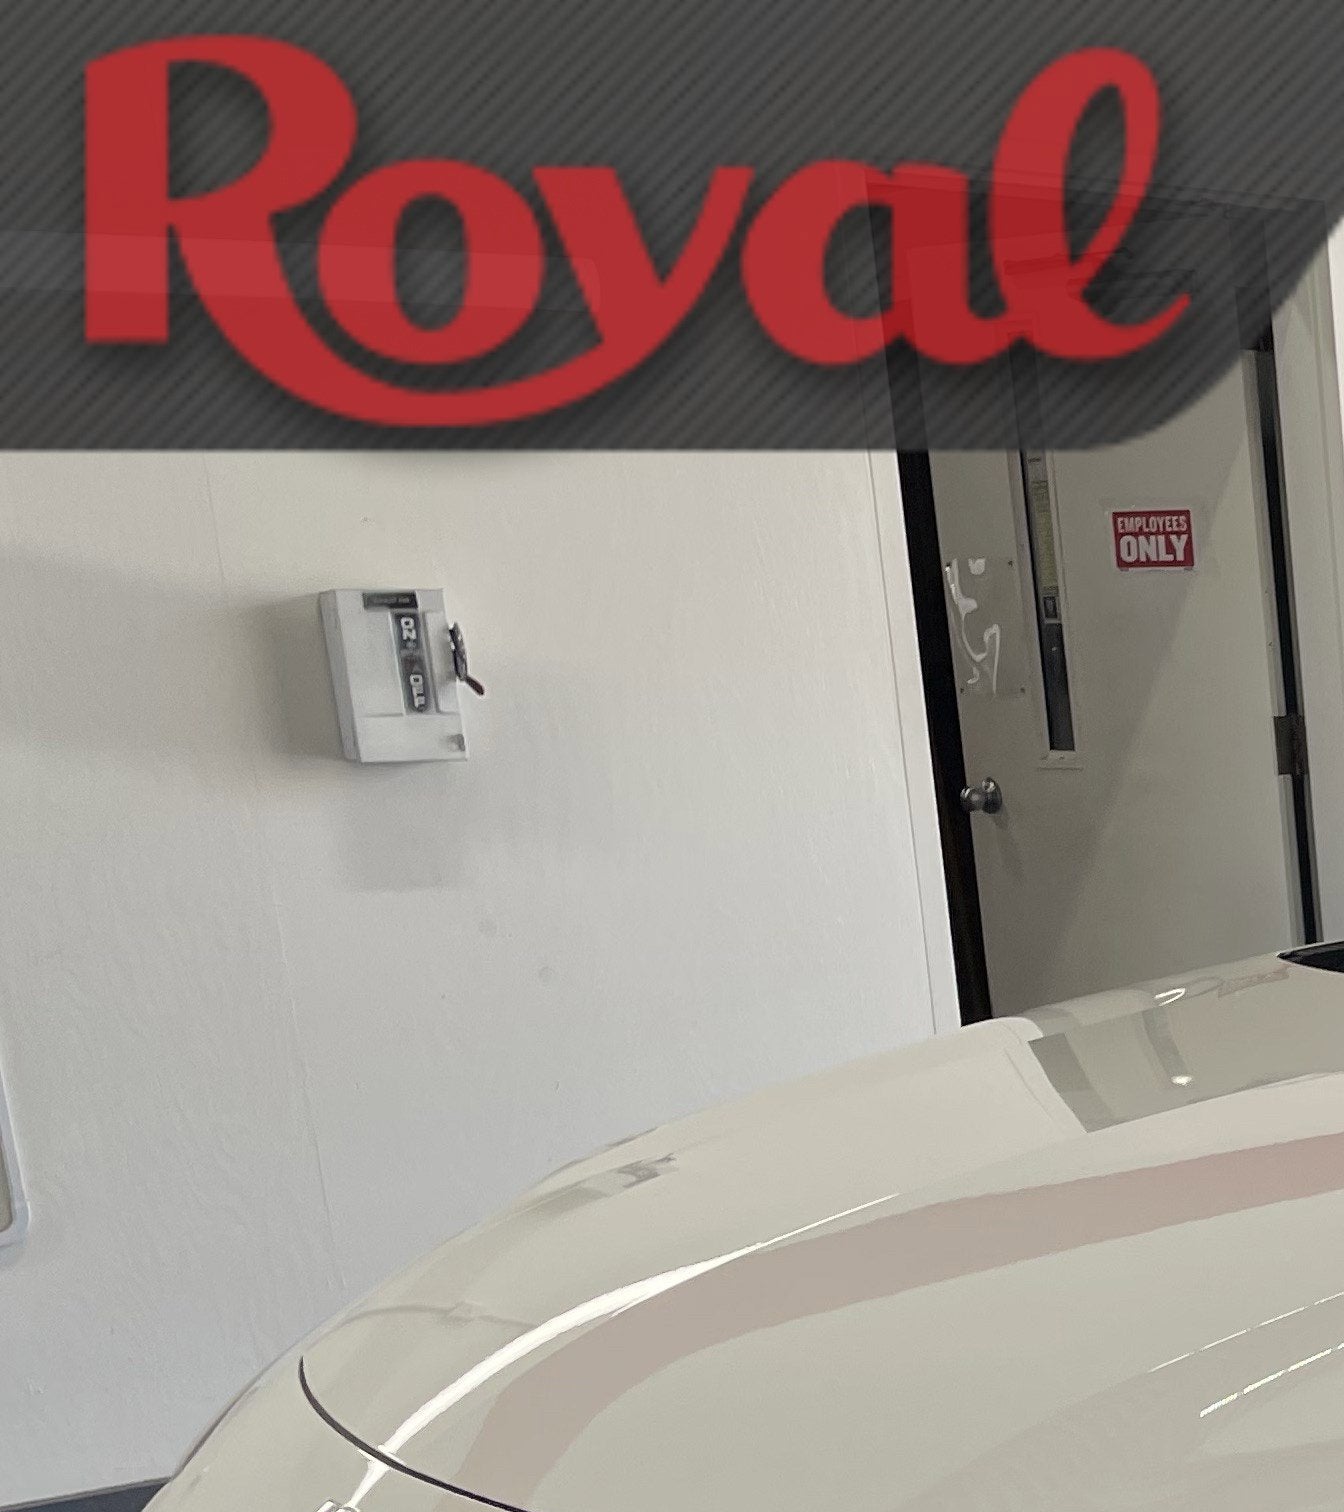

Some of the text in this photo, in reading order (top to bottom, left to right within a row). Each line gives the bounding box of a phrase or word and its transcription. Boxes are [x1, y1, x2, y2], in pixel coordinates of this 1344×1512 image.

[1117, 515, 1188, 533] EMPLOYEES
[1119, 534, 1188, 563] ONLY
[400, 616, 417, 641] ON
